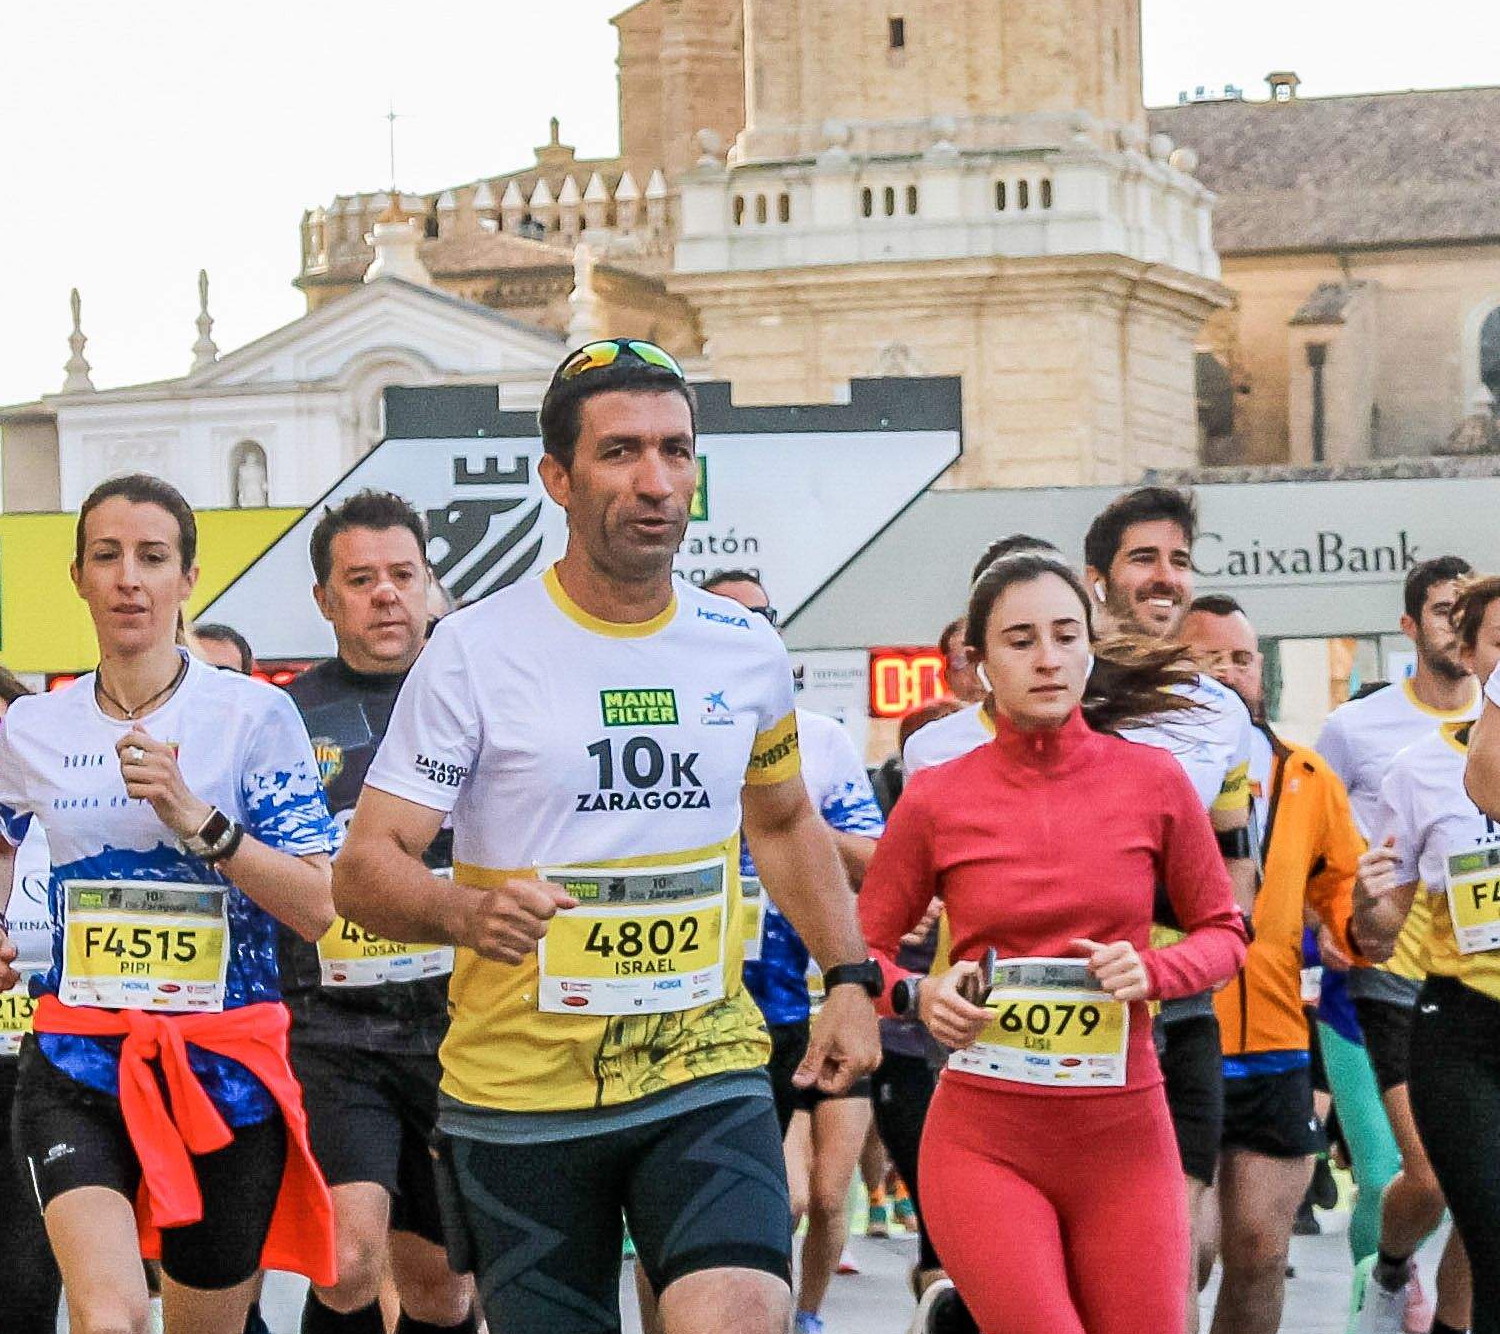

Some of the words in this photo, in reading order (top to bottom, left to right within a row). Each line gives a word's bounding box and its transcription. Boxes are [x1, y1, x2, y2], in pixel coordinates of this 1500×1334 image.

[679, 526, 760, 556] atón
[1190, 530, 1420, 577] CaixaBank
[696, 607, 750, 630] HOKA
[603, 691, 674, 709] MANN
[605, 707, 676, 724] FILTER
[585, 736, 703, 791] 10K
[574, 790, 711, 813] ZARAGOZA
[84, 927, 198, 963] F4515
[584, 915, 700, 958] 4802
[119, 961, 151, 975] PIPI
[615, 958, 677, 975] ISRAEL
[986, 1004, 1101, 1036] 6079
